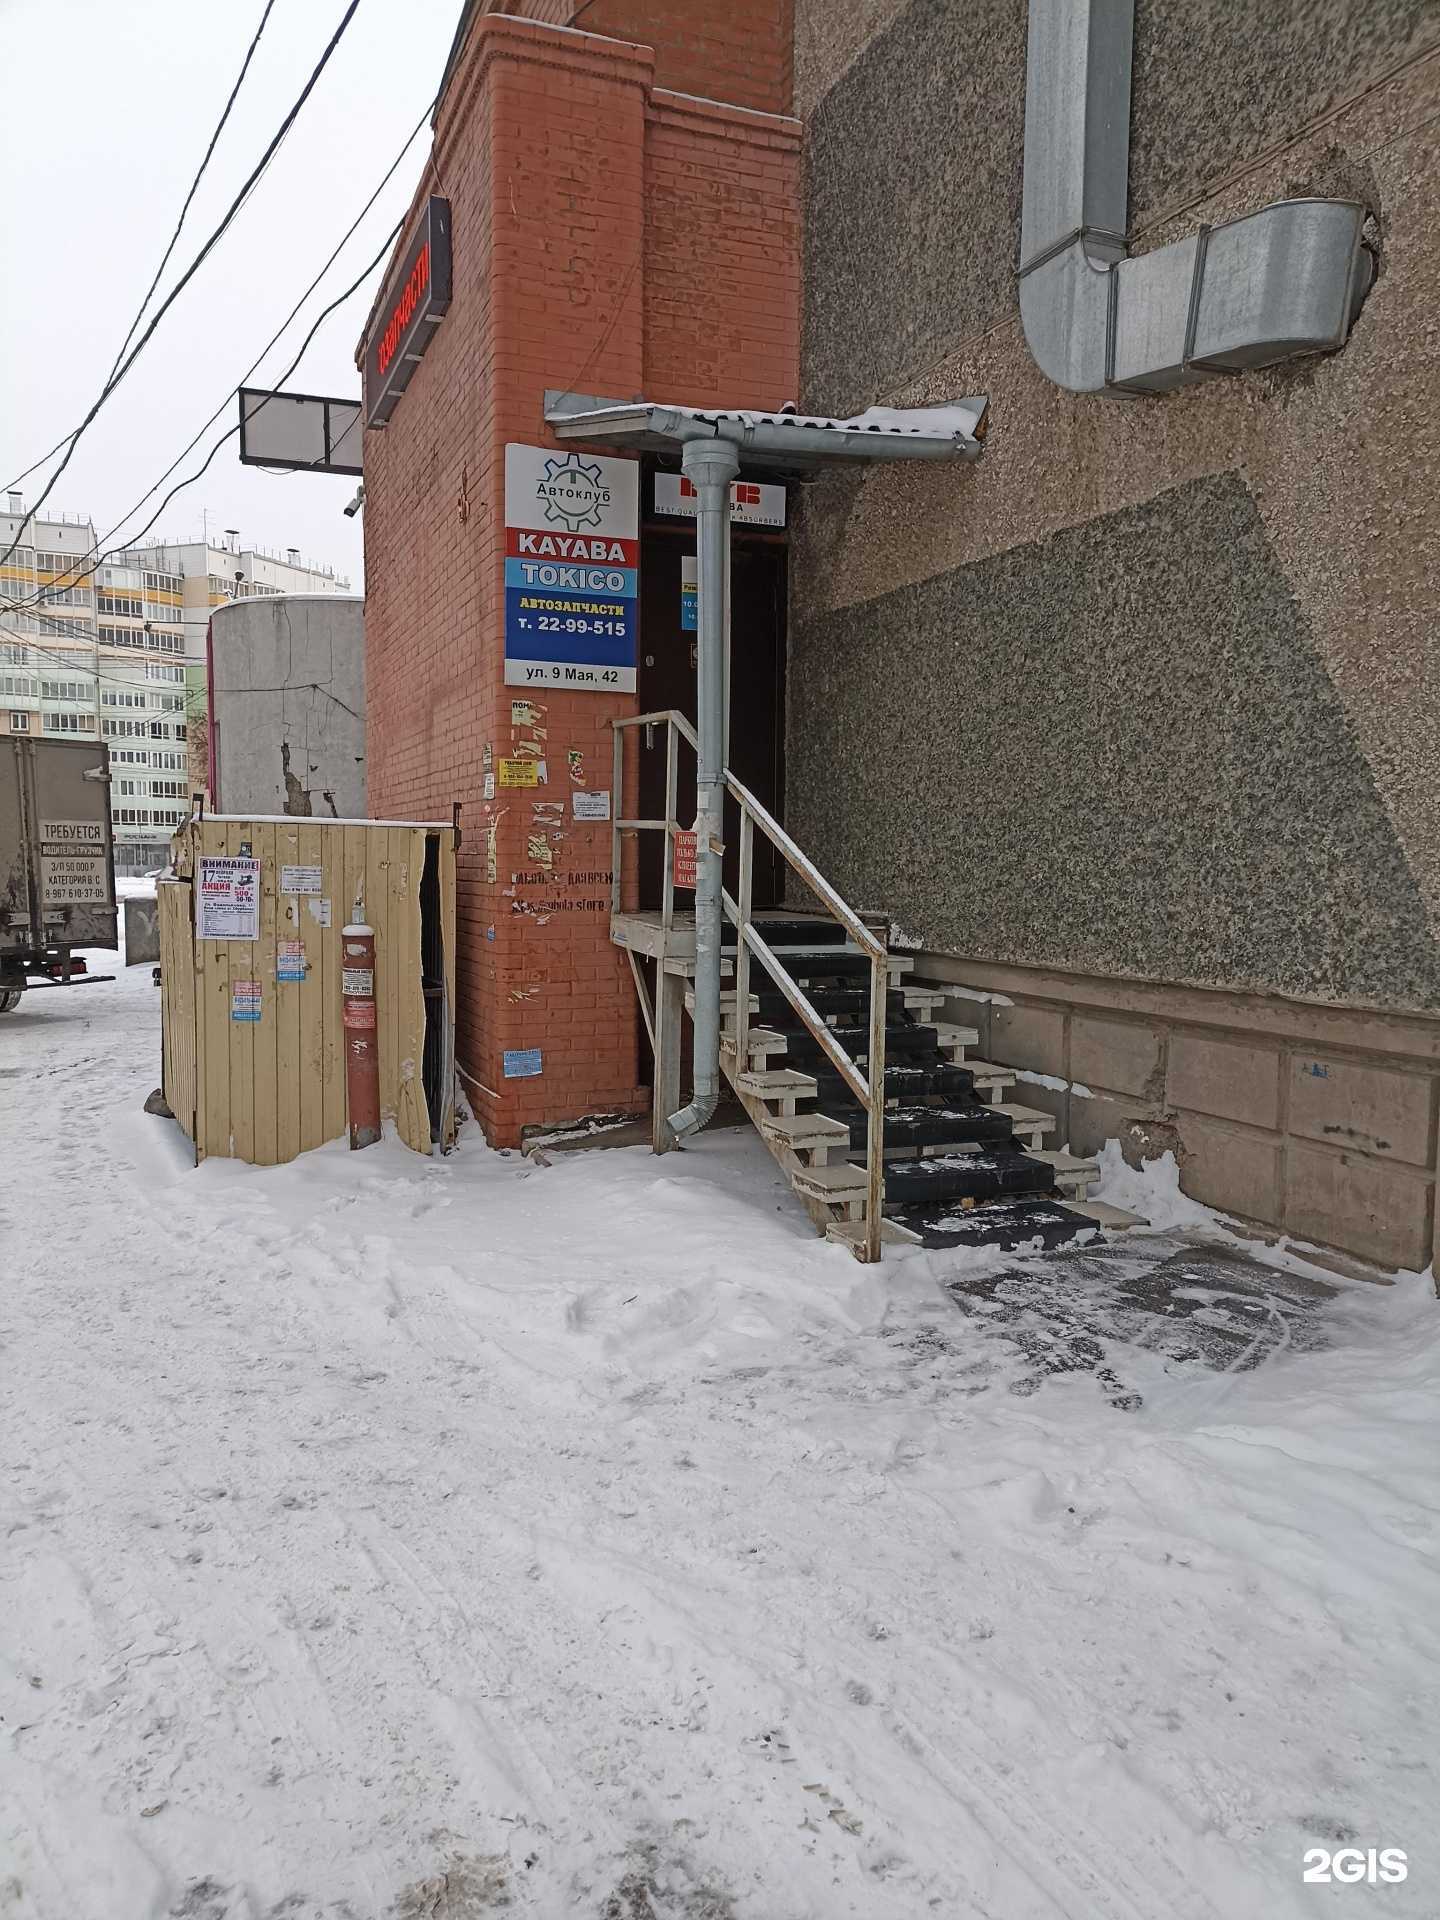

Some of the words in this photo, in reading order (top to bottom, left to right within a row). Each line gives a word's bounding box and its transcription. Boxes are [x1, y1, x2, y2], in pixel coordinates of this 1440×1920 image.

[537, 482, 611, 503] Автоклуб
[519, 533, 626, 562] KAYABA
[521, 563, 625, 592] TOKICO
[520, 597, 625, 616] АВТОЗАПЧАСТИ
[538, 616, 626, 636] 22-99-515
[526, 667, 547, 680] ул.
[552, 667, 560, 679] 9
[565, 668, 598, 682] Мая,
[601, 671, 618, 682] 42
[44, 824, 101, 839] ТРЕБУЕТСЯ
[48, 875, 87, 885] КАТЕГОРИЯ
[202, 870, 216, 882] 17
